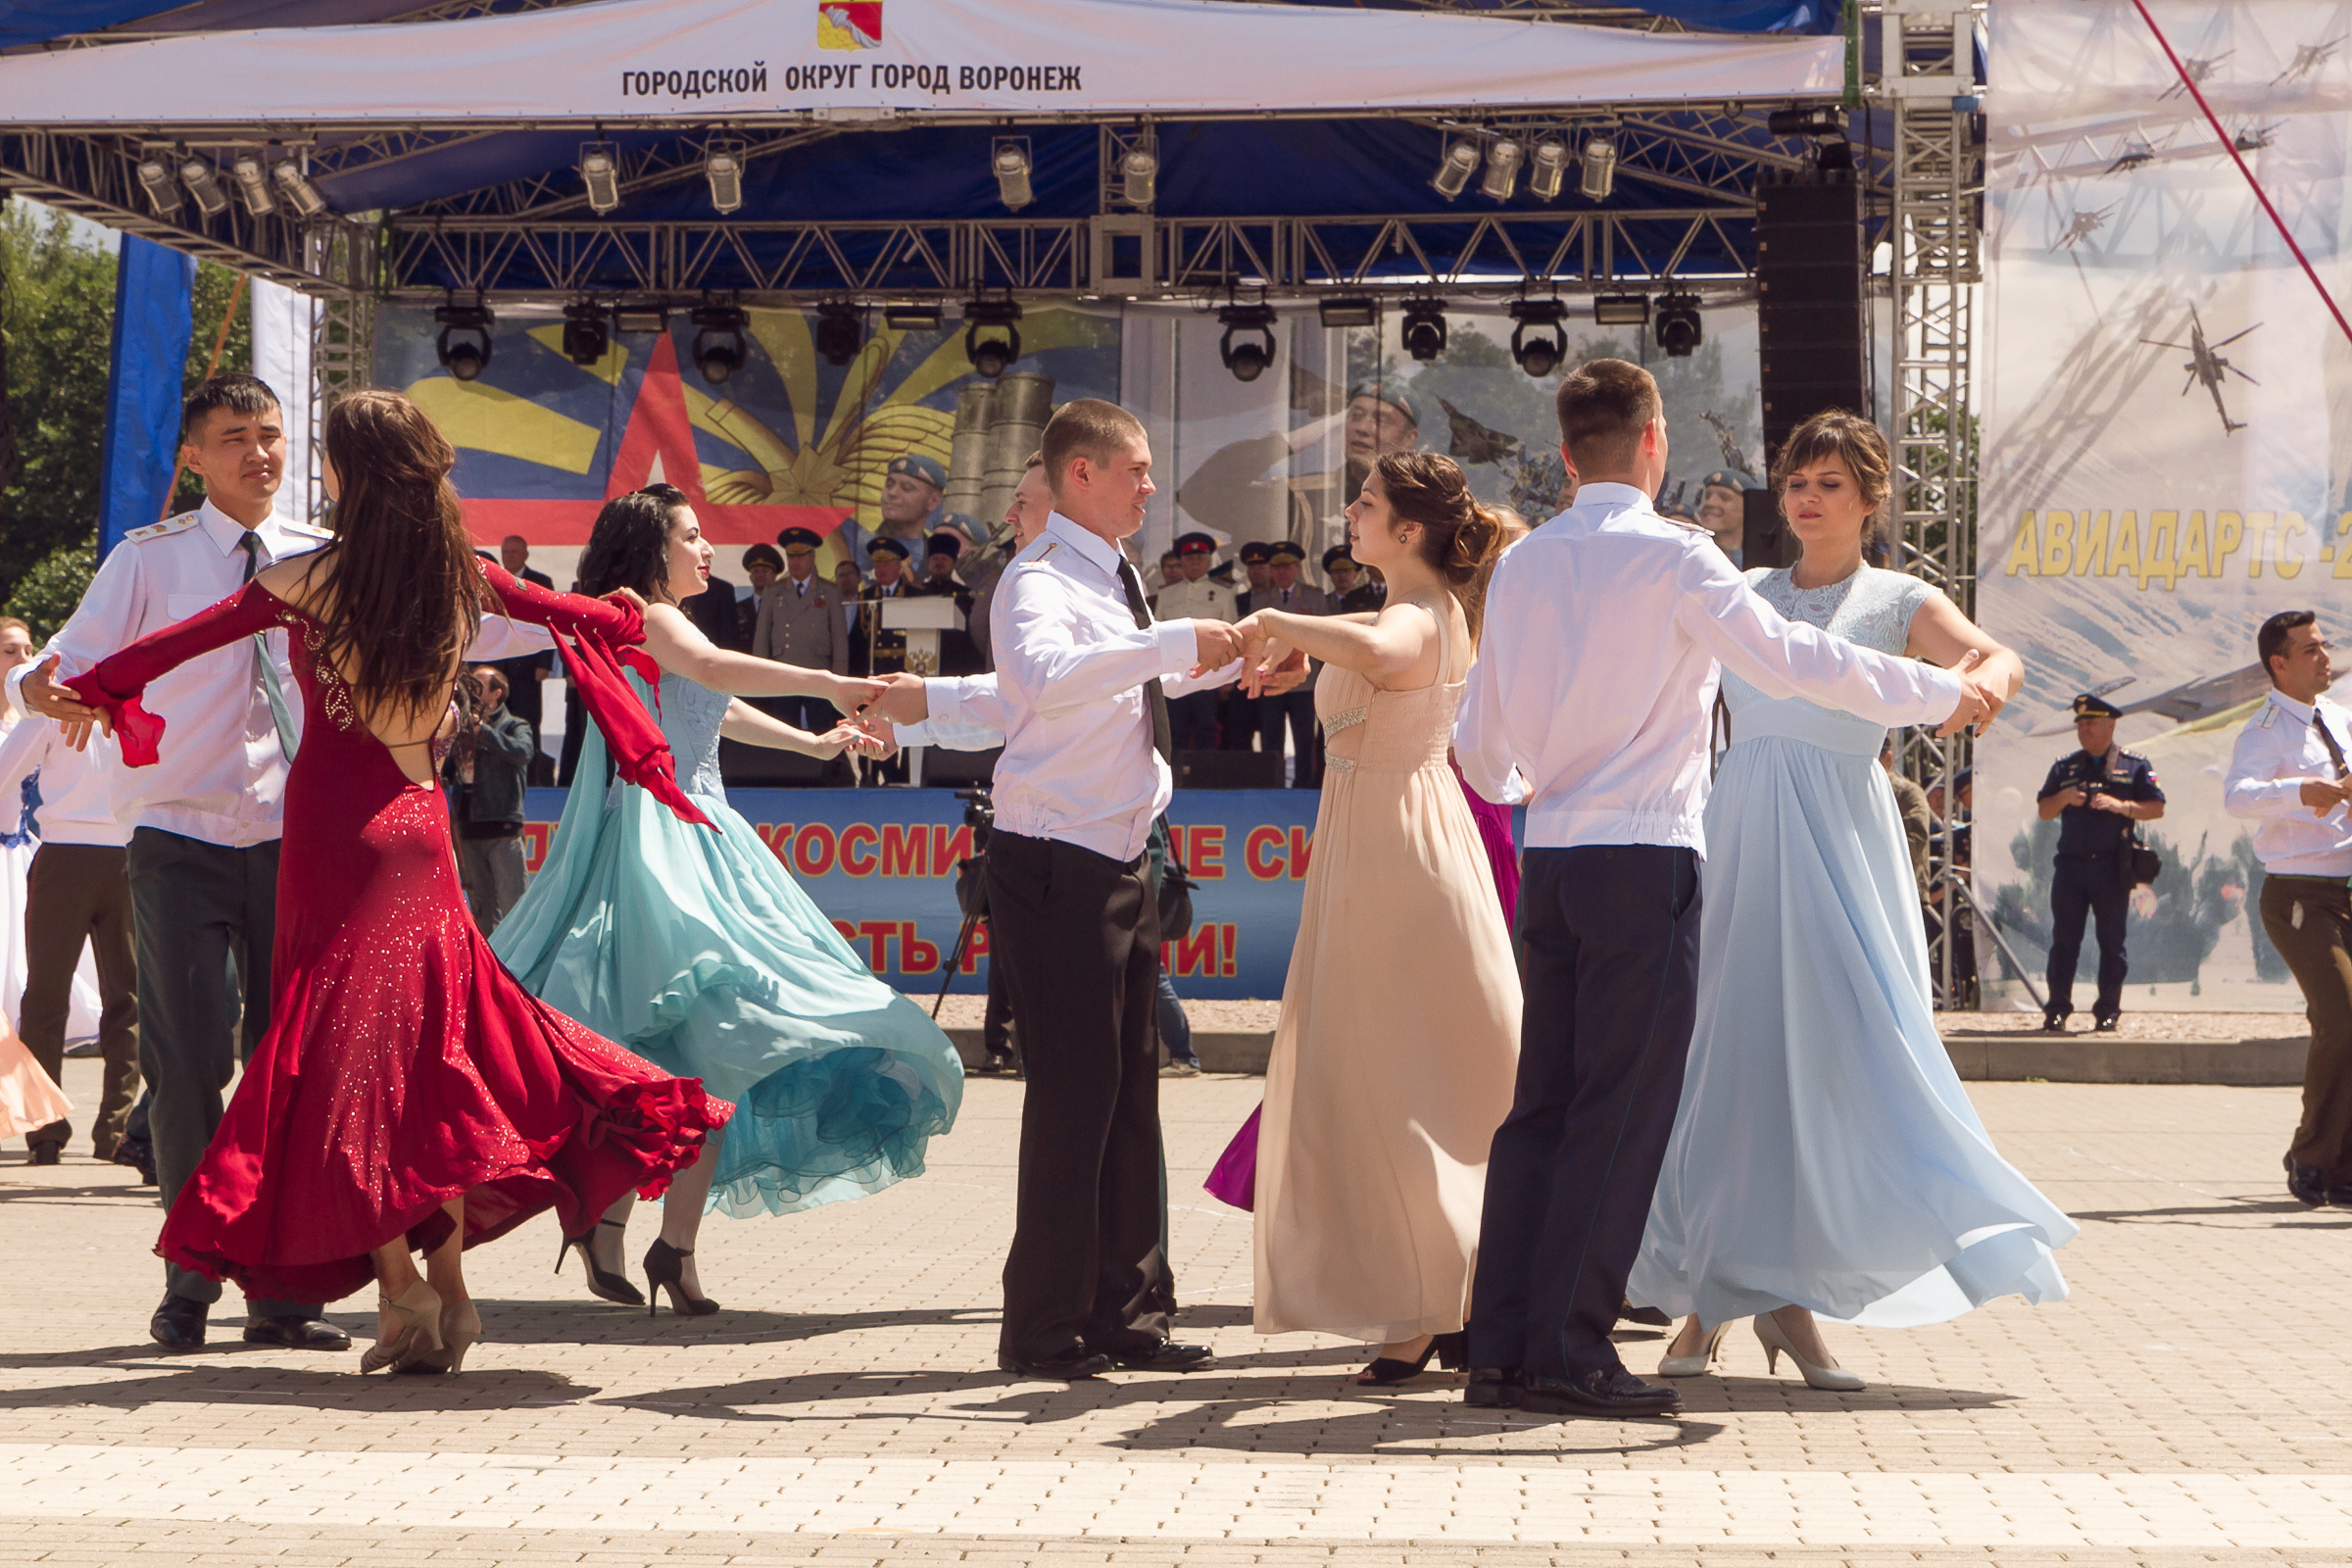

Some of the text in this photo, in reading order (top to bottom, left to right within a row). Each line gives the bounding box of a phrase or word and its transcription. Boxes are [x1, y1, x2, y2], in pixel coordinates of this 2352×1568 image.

[622, 60, 1082, 99] ГОРОДСКОЙ ОКРУГ ГОРОД ВОРОНЕЖ
[2006, 509, 2307, 592] АВИАДАРТС
